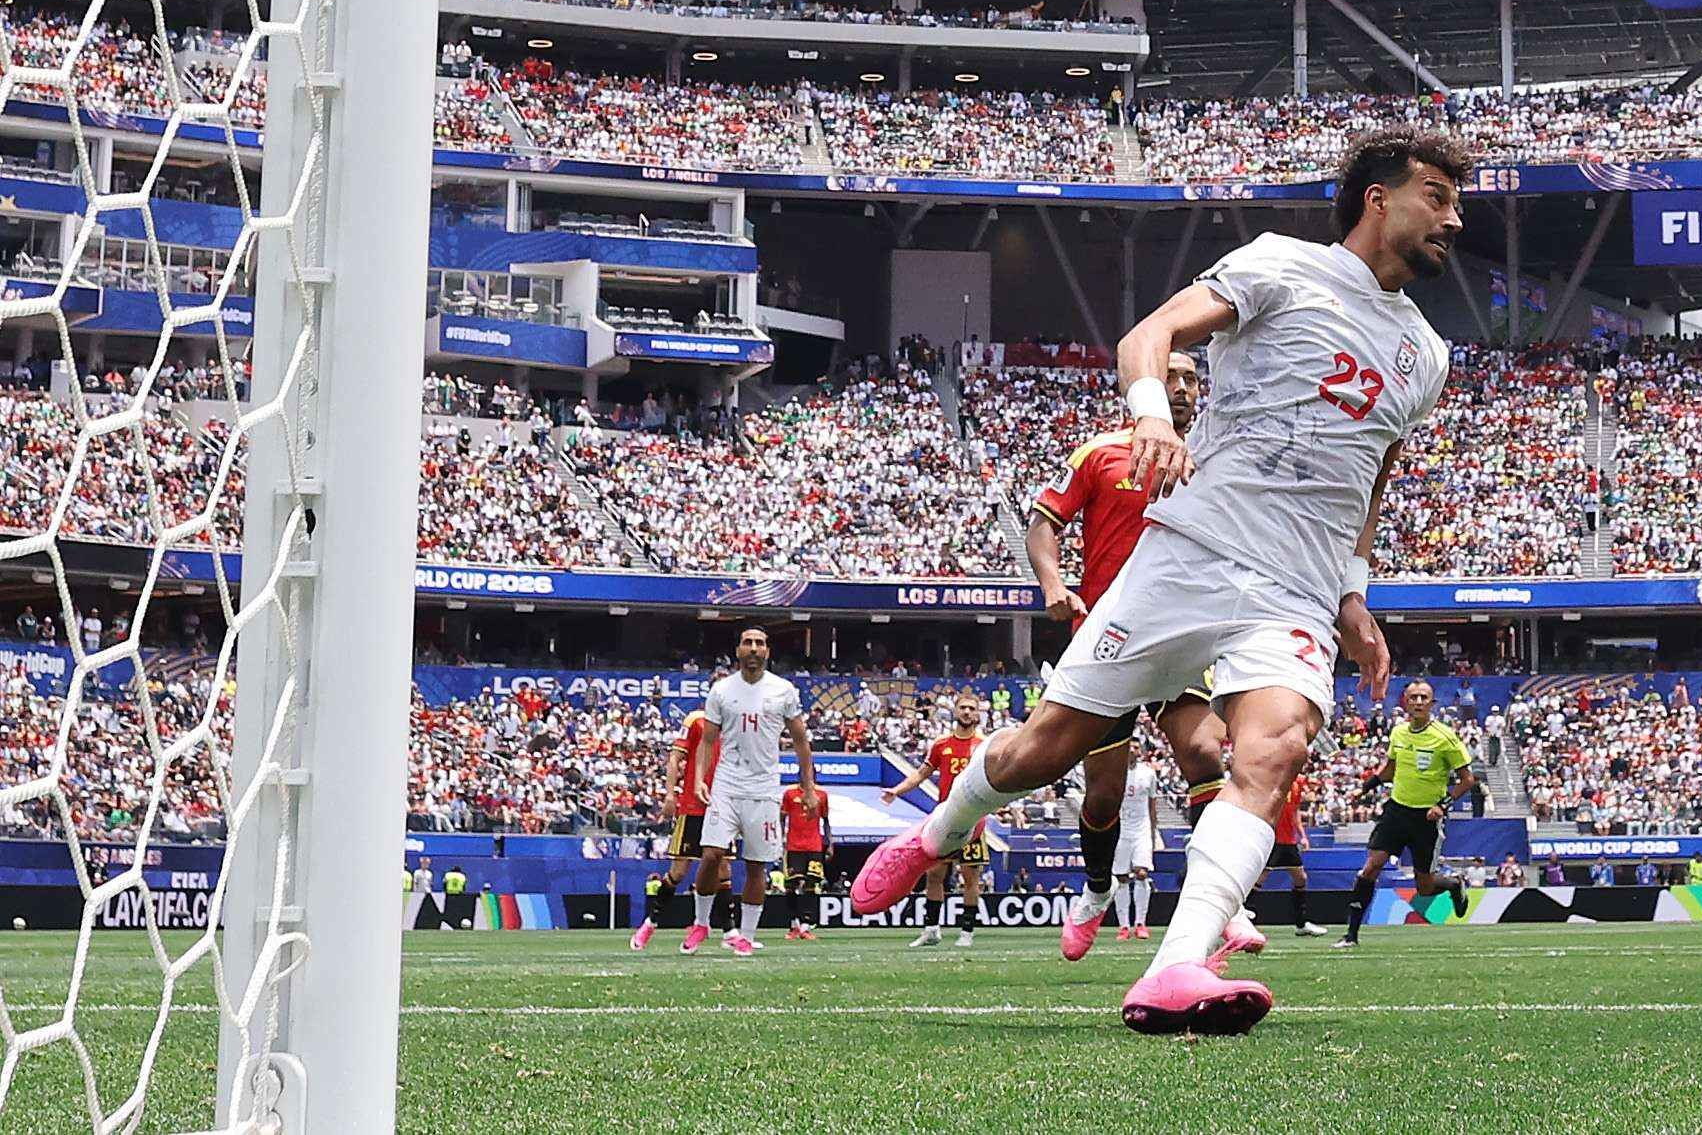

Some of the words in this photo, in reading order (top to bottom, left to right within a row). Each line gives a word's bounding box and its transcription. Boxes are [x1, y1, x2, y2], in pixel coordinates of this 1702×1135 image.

[1319, 351, 1384, 420] 23
[415, 569, 449, 589] RLD
[450, 572, 487, 590] CUP
[487, 574, 554, 594] 2026
[898, 588, 939, 605] LOS
[942, 588, 1034, 606] ANGELES
[493, 677, 553, 696] LOS
[742, 713, 758, 733] 14
[1036, 855, 1065, 868] LOS
